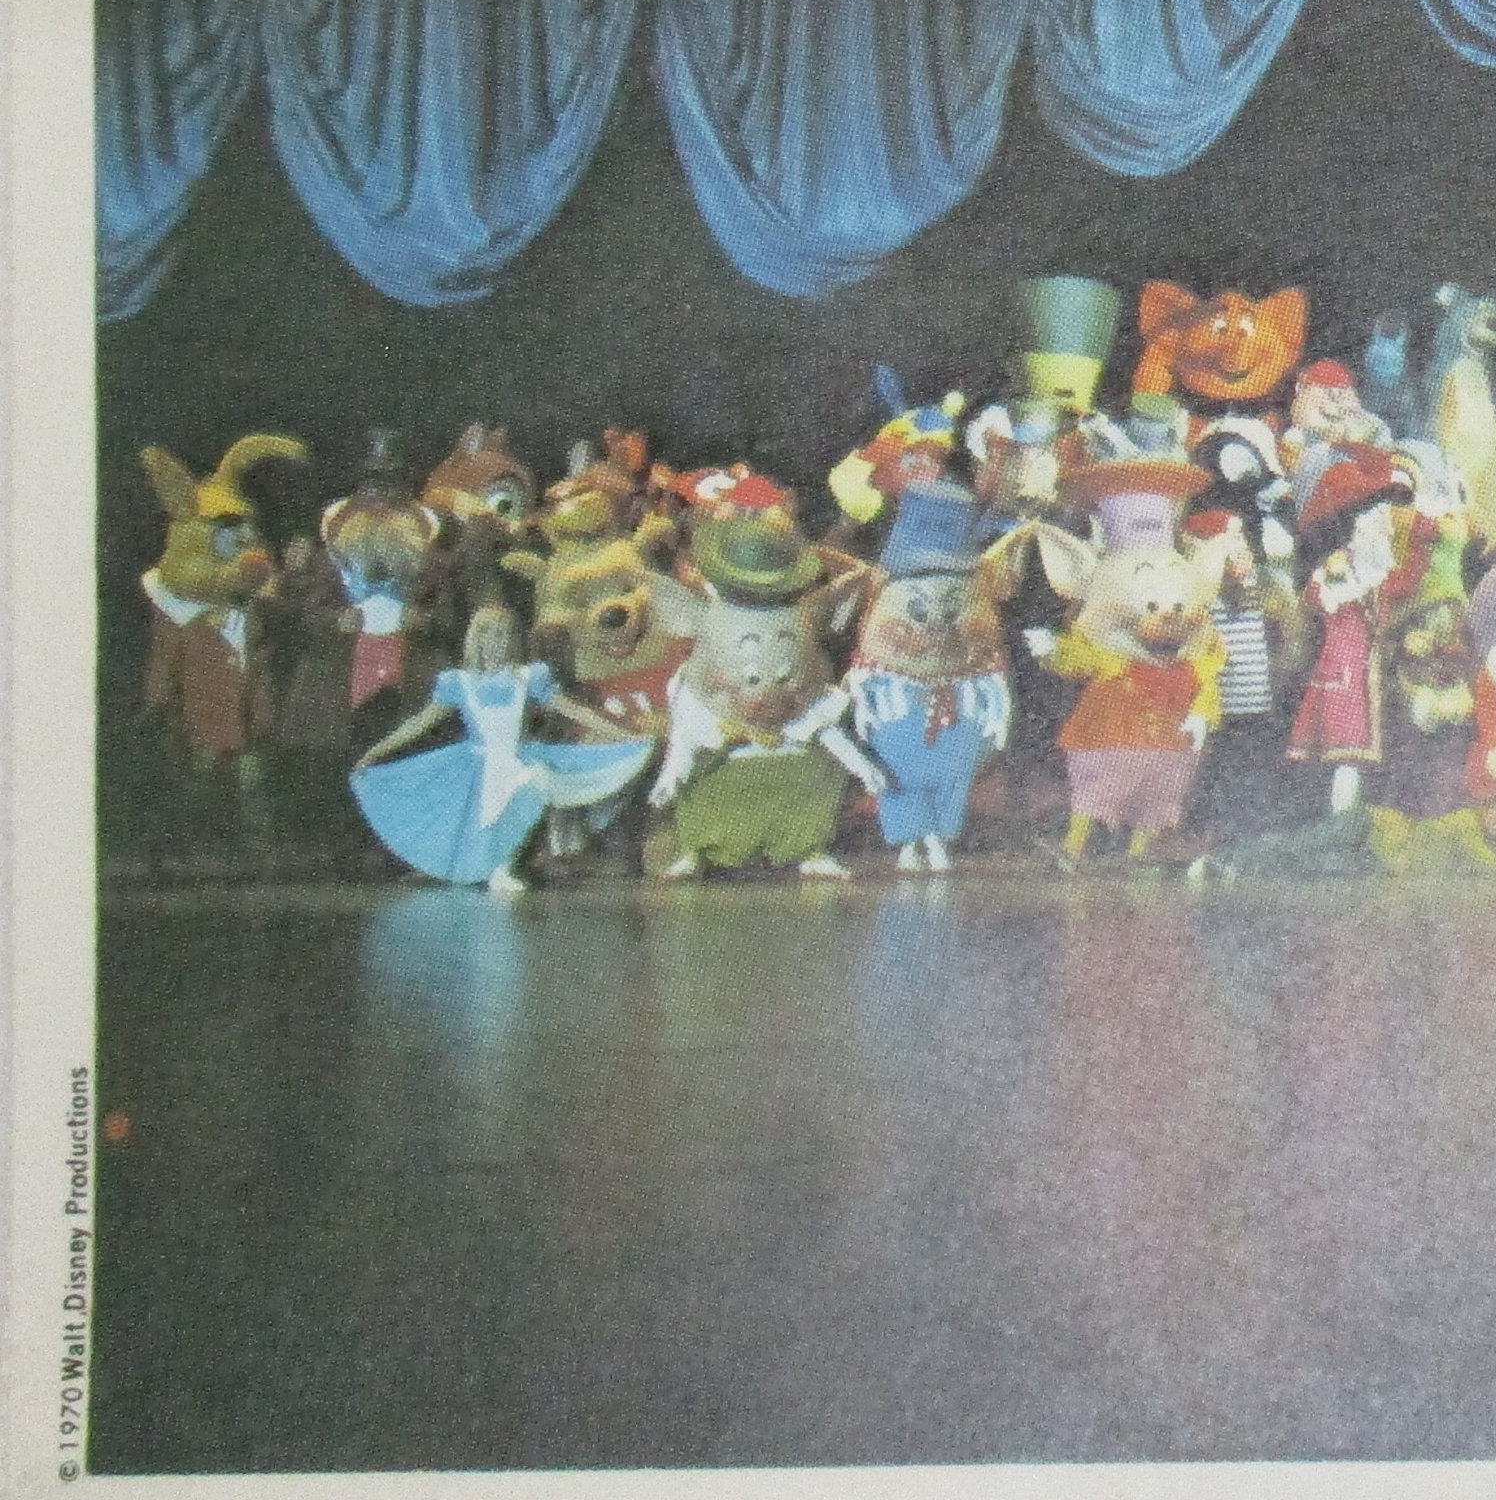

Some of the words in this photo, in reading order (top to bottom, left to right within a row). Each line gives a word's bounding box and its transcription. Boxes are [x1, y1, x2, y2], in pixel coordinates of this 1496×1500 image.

[65, 1066, 89, 1216] Productions
[62, 1226, 92, 1314] Disney
[60, 1386, 84, 1450] 1970
